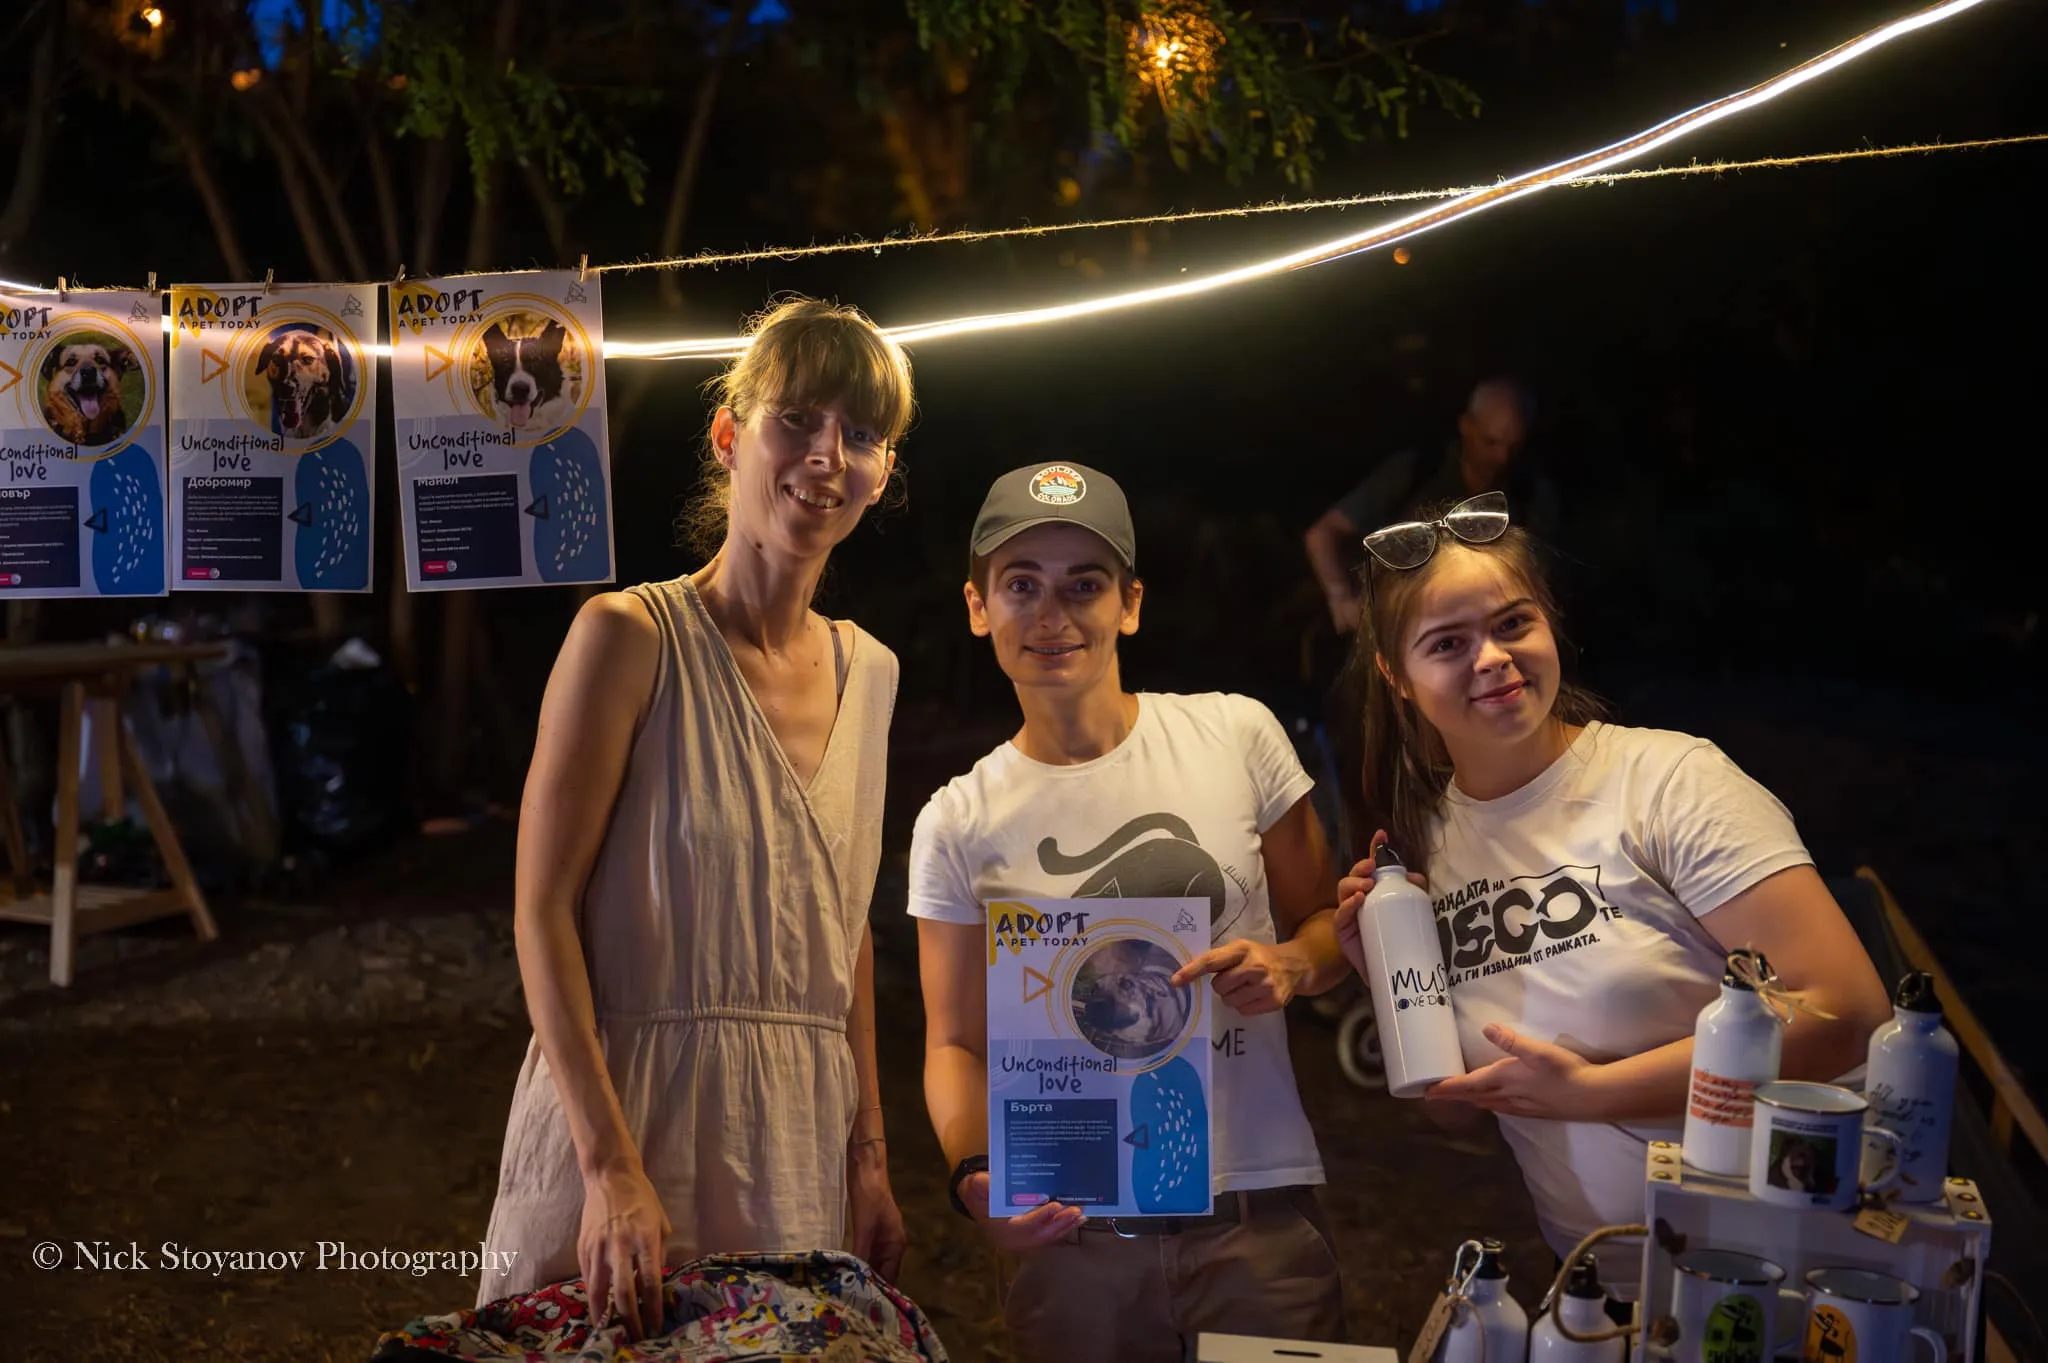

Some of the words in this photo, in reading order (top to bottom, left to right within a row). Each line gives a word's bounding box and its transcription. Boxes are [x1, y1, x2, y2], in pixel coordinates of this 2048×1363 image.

[179, 295, 263, 317] ADOPT
[398, 289, 485, 315] ADOPT
[0, 306, 52, 329] OPT
[179, 321, 186, 330] A
[192, 321, 214, 330] PET
[221, 320, 261, 329] TODAY
[398, 320, 406, 328] A
[413, 317, 435, 327] PET
[441, 314, 484, 325] TODAY
[13, 330, 52, 340] TODAY
[181, 433, 285, 457] Unconditional
[409, 427, 516, 451] Unconditional
[0, 443, 78, 464] conditional
[213, 451, 251, 472] love
[444, 448, 484, 470] love
[11, 462, 47, 481] love
[188, 477, 251, 489] Добромир
[0, 488, 31, 500] овър
[996, 911, 1090, 934] ADOPT
[996, 938, 1004, 947] A
[1011, 938, 1035, 947] PET
[1044, 937, 1089, 947] TODAY
[1465, 968, 1479, 981] ГИ
[1483, 955, 1532, 977] ИЗВАДИМ
[1534, 950, 1544, 963] ОТ
[1545, 933, 1601, 958] РАМКАТА.
[1002, 1055, 1117, 1077] Unconditional
[1039, 1073, 1082, 1094] love
[1011, 1102, 1053, 1114] Бърта
